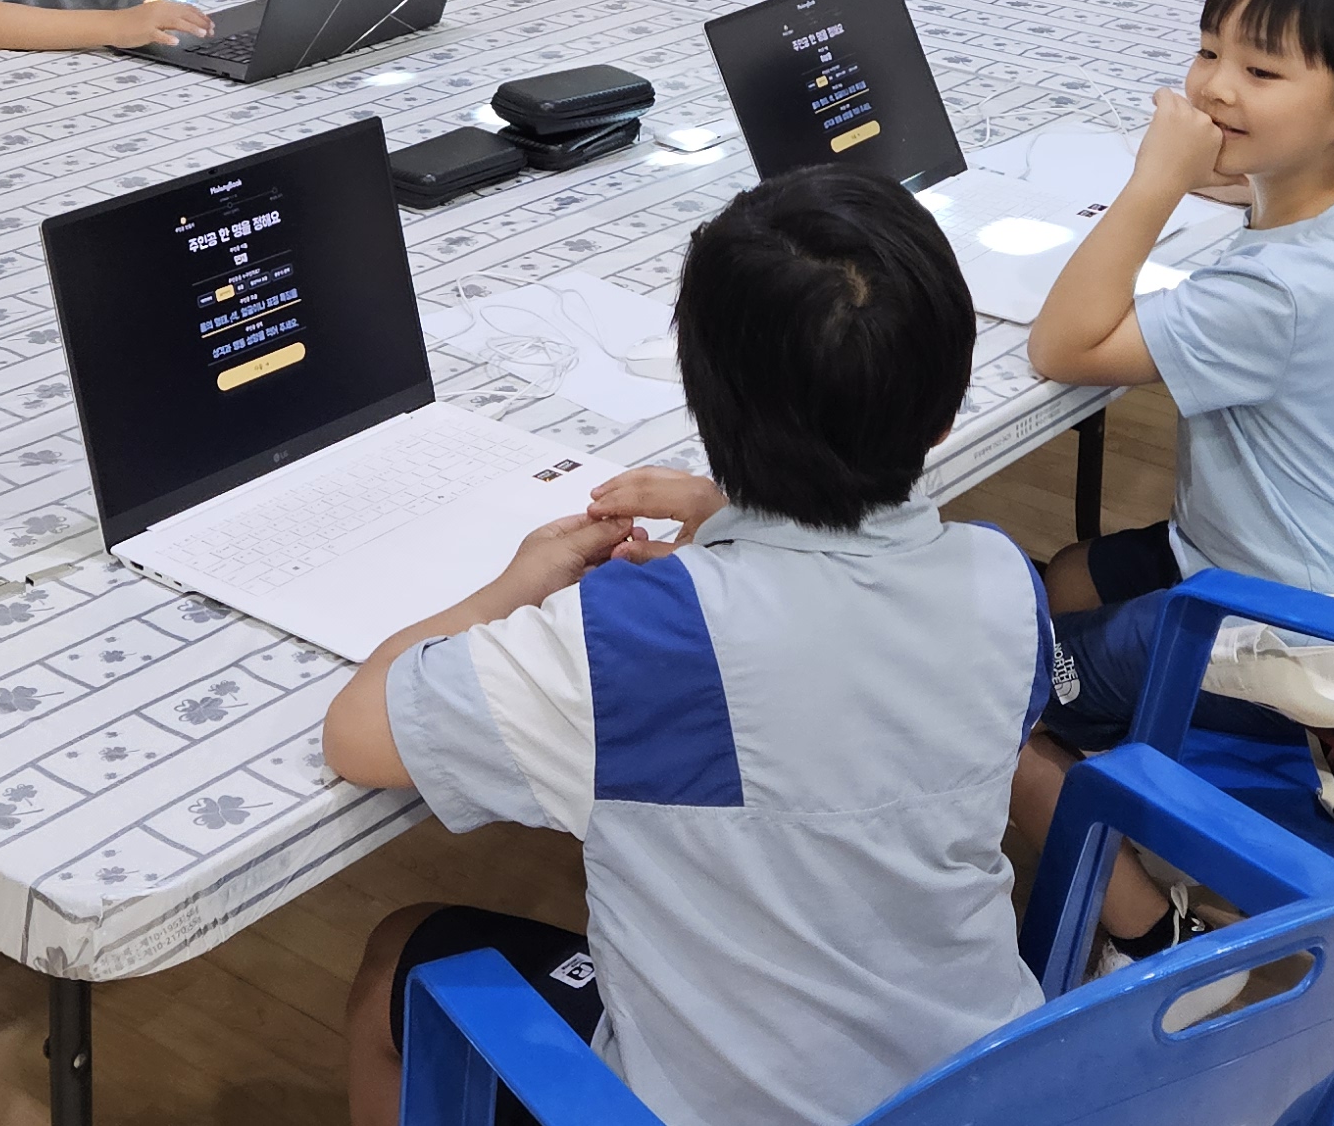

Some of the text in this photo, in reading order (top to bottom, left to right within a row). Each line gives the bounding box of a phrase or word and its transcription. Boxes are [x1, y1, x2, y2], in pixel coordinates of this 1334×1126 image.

[188, 210, 281, 252] 주인공 한 명을 정해요
[1055, 643, 1070, 683] NORTH
[1065, 656, 1078, 680] THE
